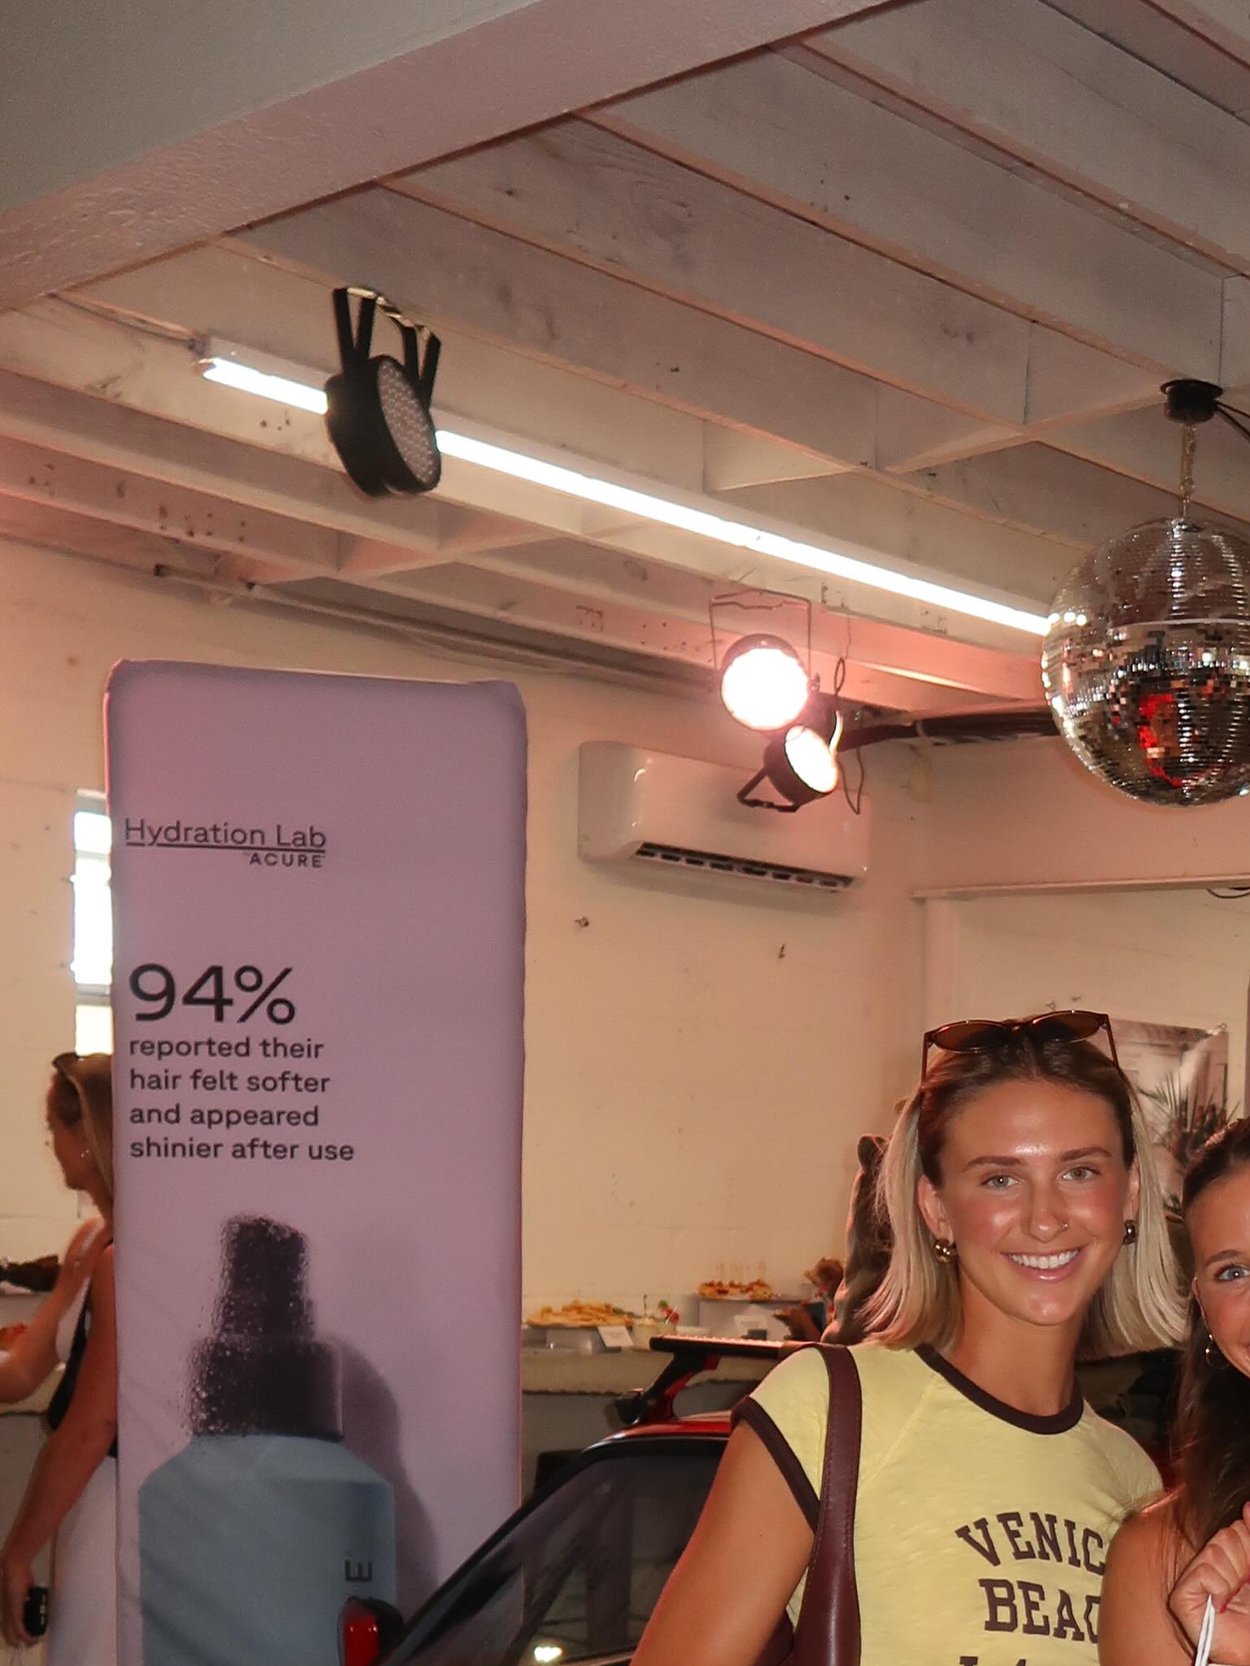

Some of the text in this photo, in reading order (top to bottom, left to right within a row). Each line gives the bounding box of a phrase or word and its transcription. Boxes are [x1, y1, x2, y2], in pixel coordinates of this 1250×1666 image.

[125, 818, 327, 848] Hydration Lab
[249, 852, 324, 868] ACURE
[129, 963, 296, 1025] 94%
[129, 1037, 325, 1060] reported their
[130, 1068, 331, 1092] hair felt softer
[130, 1103, 319, 1130] and appeared
[131, 1136, 354, 1160] shinier after use
[954, 1511, 1106, 1576] VENIC
[978, 1578, 1101, 1644] BEAC
